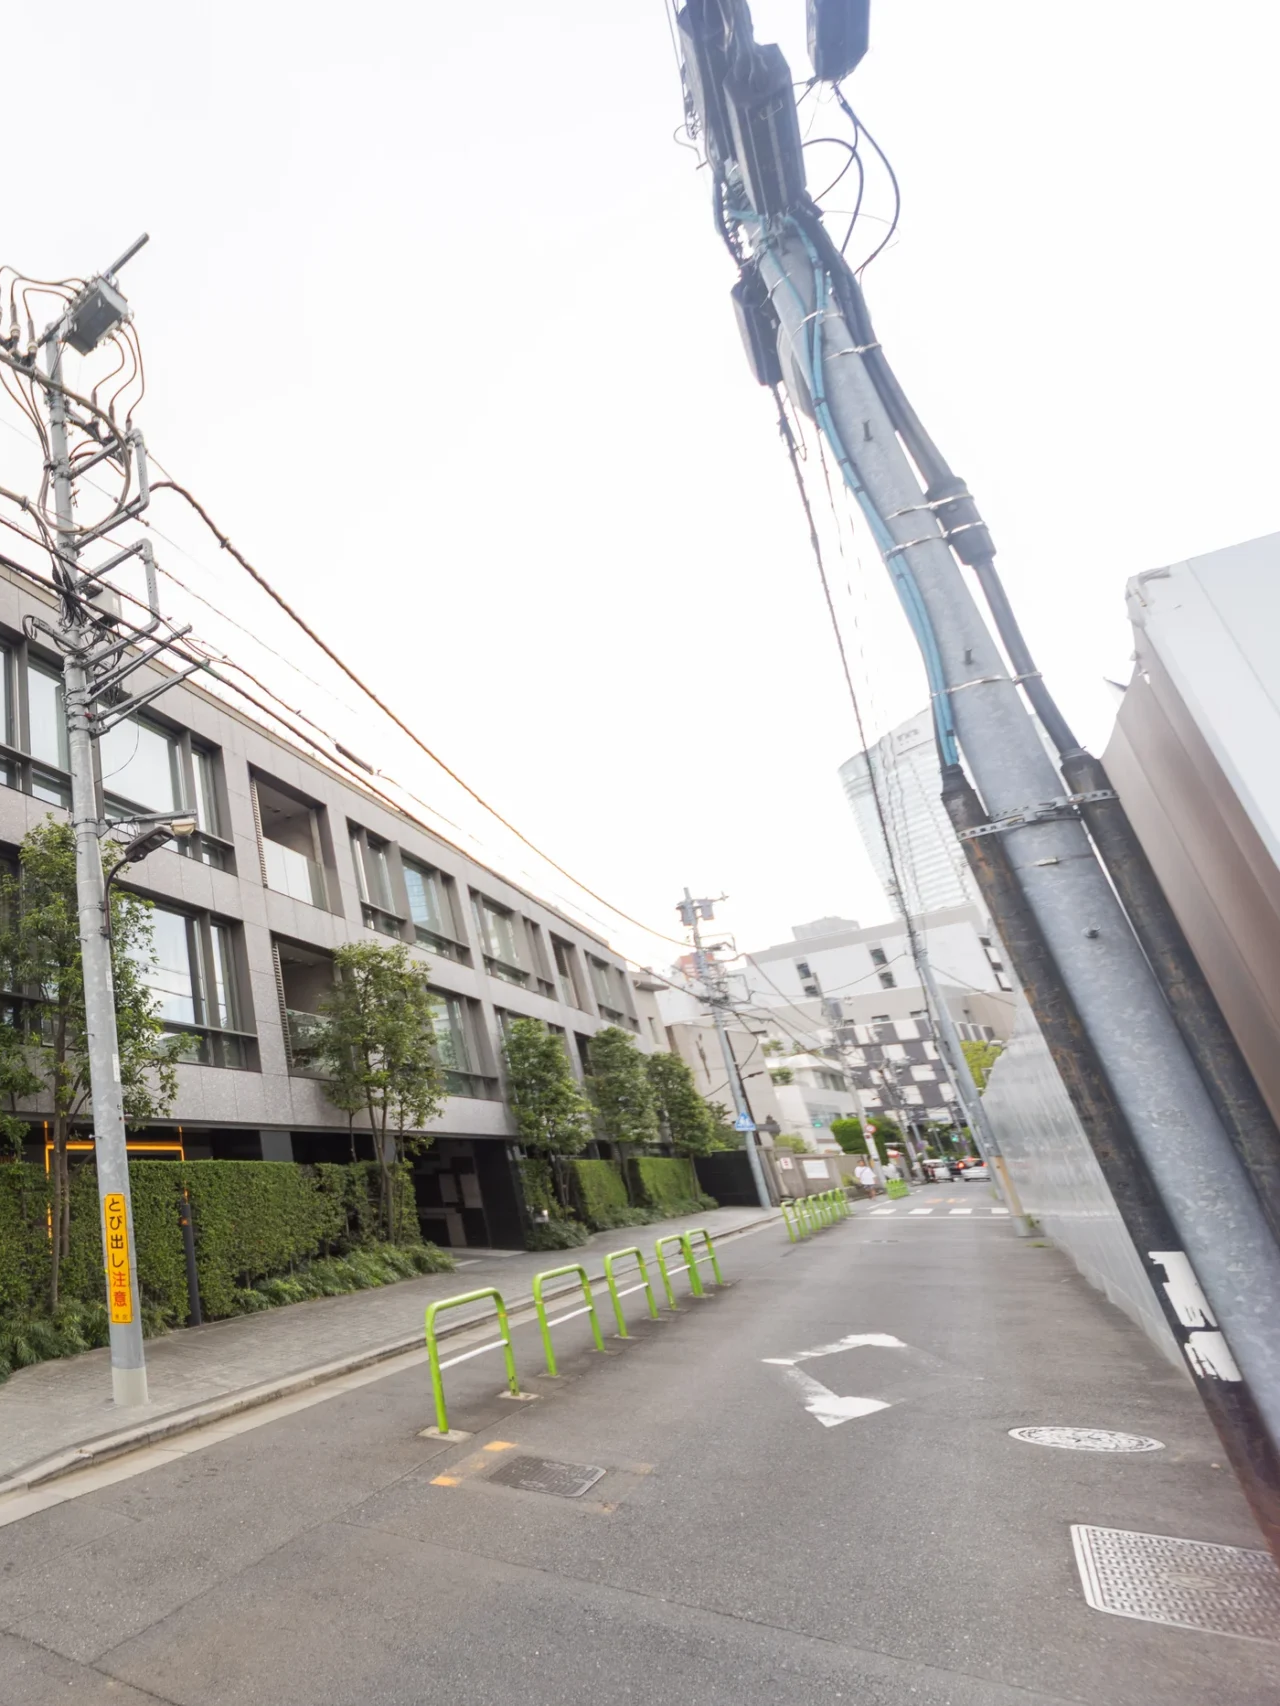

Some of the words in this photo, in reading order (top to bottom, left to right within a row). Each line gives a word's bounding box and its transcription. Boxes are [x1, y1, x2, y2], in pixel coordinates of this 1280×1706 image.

[108, 1197, 128, 1308] とび出し注意
